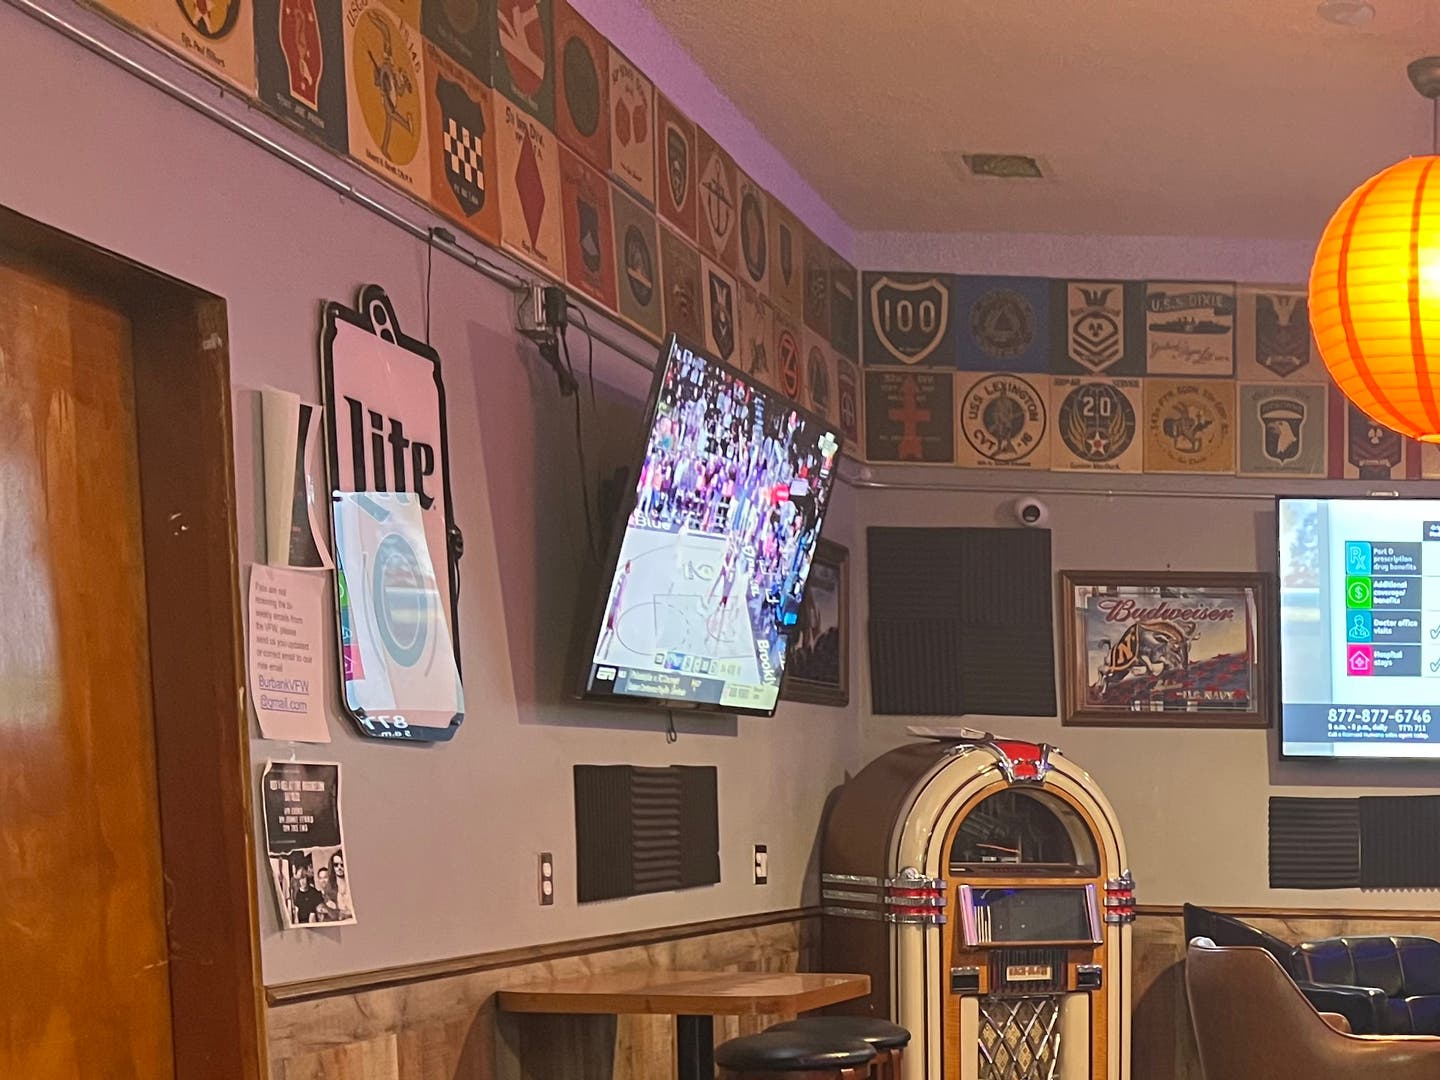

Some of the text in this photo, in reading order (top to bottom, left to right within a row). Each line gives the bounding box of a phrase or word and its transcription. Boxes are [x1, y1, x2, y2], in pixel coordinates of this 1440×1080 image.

[884, 298, 936, 334] 100
[968, 394, 984, 420] USS
[1083, 396, 1112, 417] 20
[1373, 554, 1414, 565] prescription
[1373, 562, 1418, 573] drug benefits
[1098, 599, 1235, 622] Budweiser
[1373, 618, 1397, 628] Doctor
[258, 674, 310, 694] BurbankVFW
[260, 694, 308, 713] @gmail.com
[1327, 708, 1432, 724] 877-877-6746
